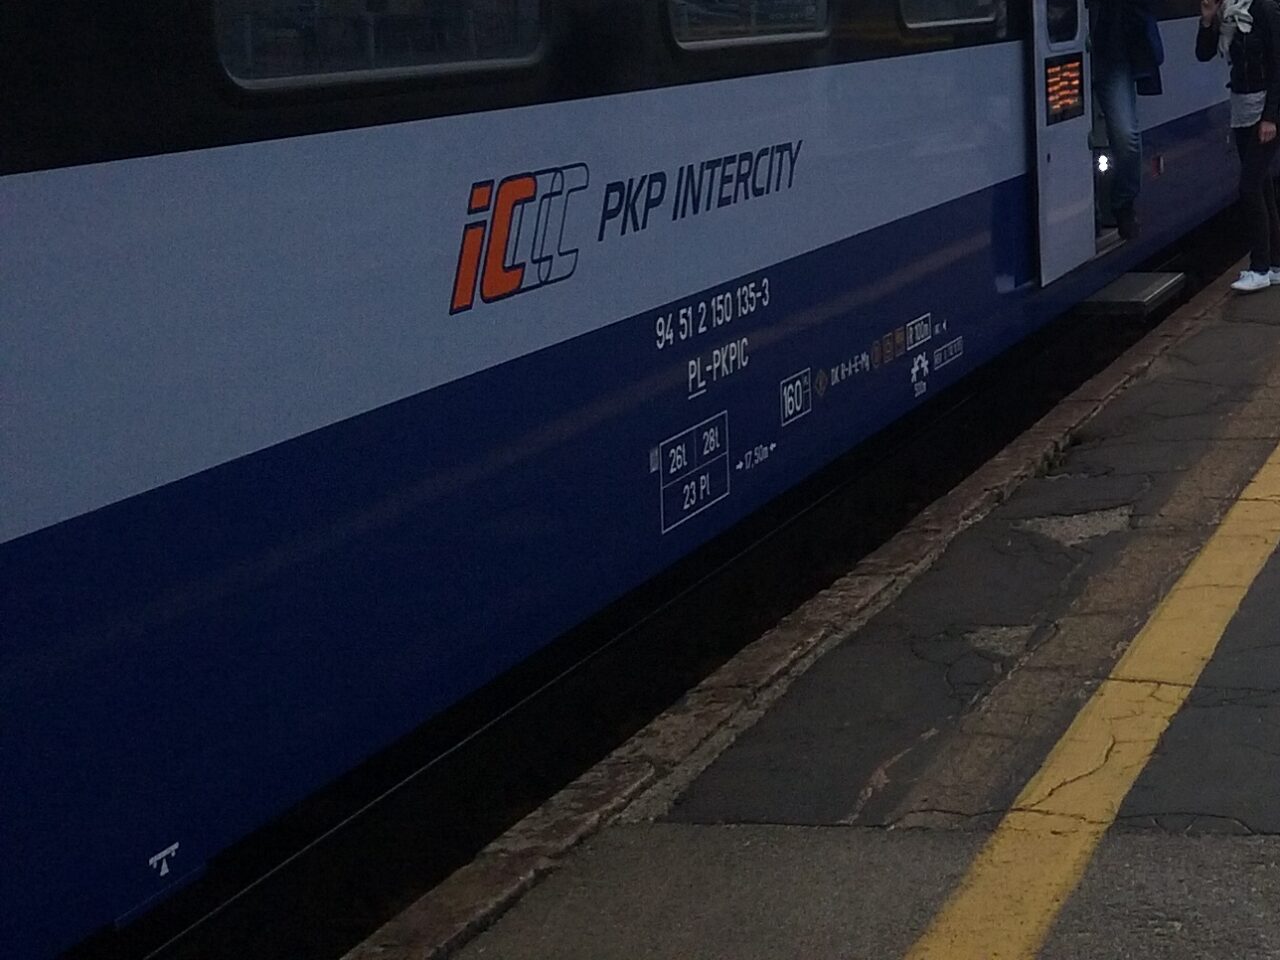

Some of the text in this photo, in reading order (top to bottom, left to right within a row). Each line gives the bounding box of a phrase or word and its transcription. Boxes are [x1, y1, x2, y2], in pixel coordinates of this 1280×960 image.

[597, 139, 803, 242] PKP INTERCITY
[656, 278, 769, 349] 94 51 2 150 135-3
[688, 337, 749, 394] PL-PKPIC
[783, 379, 803, 419] 160
[683, 481, 697, 510] 23
